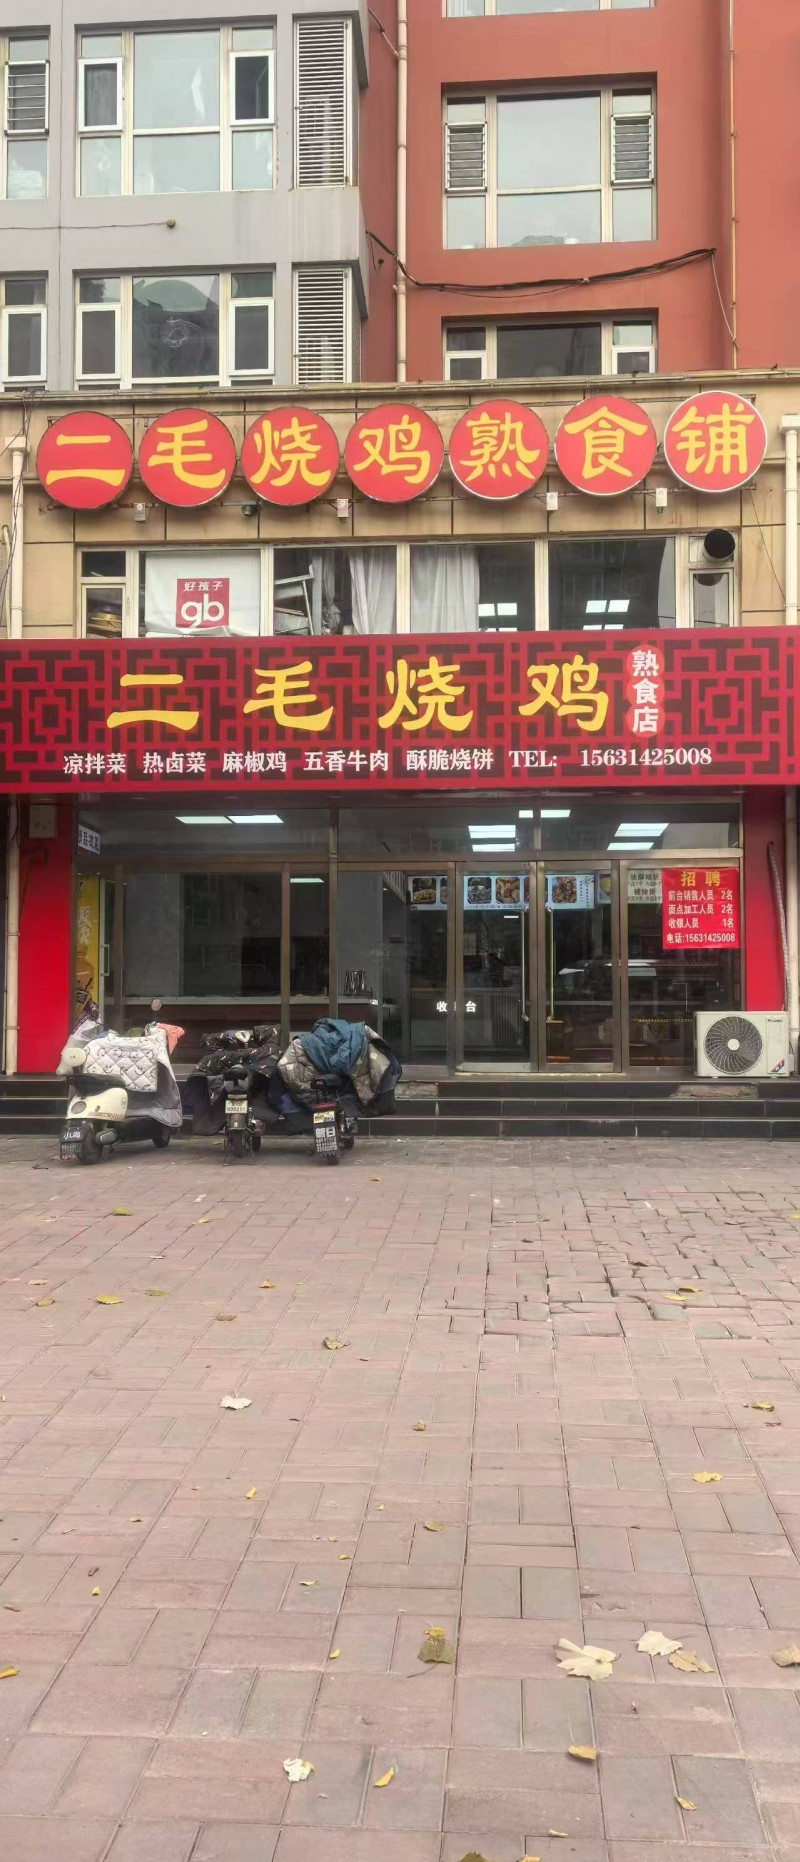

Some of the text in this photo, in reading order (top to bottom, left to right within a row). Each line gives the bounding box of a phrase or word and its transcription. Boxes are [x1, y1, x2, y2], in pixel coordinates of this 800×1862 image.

[46, 404, 754, 488] 二毛烧鸡熟食铺
[184, 581, 222, 591] 好孩子
[181, 593, 224, 628] gb
[106, 655, 609, 732] 二毛烧鸡
[632, 649, 660, 734] 熟食店
[63, 747, 712, 774] 凉拌菜 热卤菜 麻椒鸡 五香牛肉 酥脆烧饼 TEL: 15631425008
[681, 871, 721, 886] 招聘
[668, 890, 714, 901] 前台销售人员
[721, 890, 733, 900] 2名
[668, 904, 733, 914] 面点加工人员 2名
[723, 918, 734, 928] 1名
[667, 933, 735, 943] 电话:15631425008
